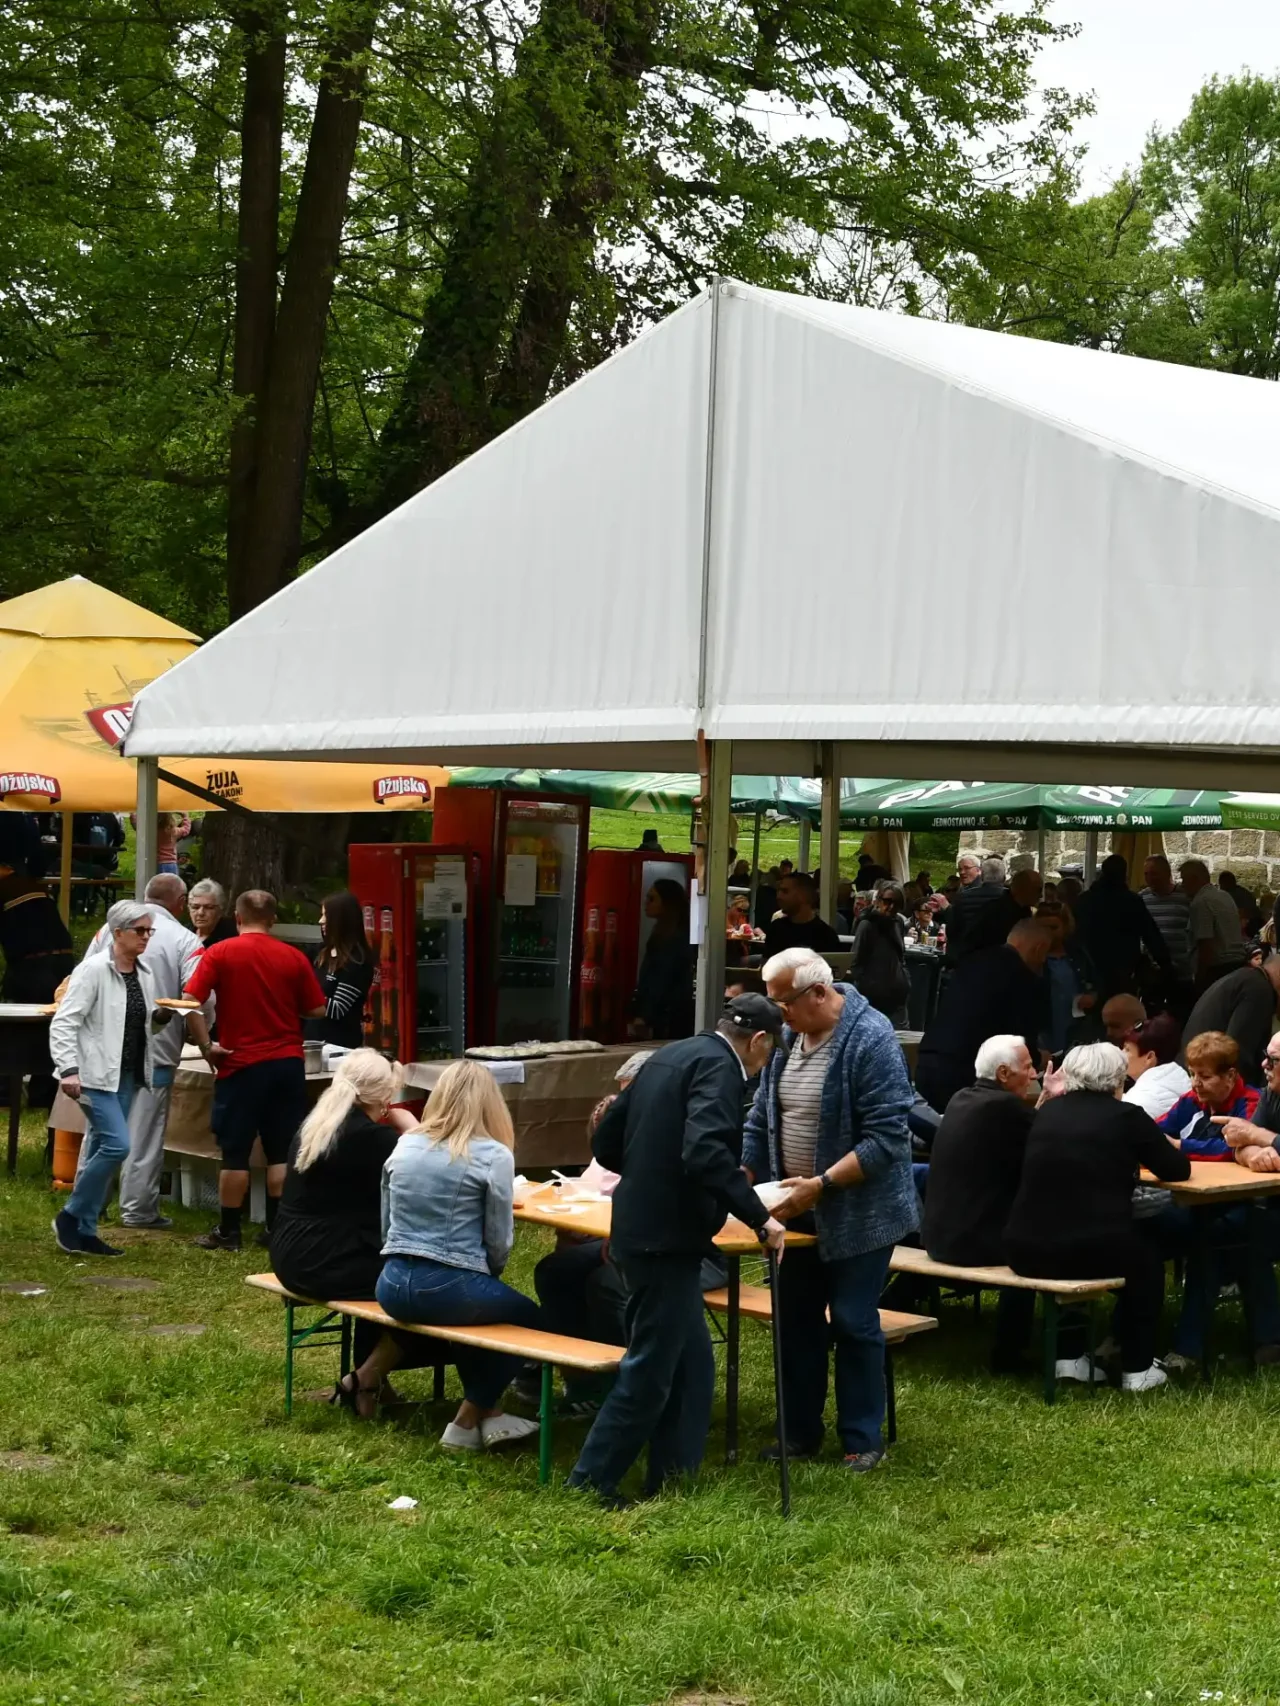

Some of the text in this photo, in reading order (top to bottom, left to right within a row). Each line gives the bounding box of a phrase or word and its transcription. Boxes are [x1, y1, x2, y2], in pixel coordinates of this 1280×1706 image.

[206, 770, 239, 791] ŽUJA
[378, 777, 427, 796] Ožujsko
[878, 780, 985, 809] PA
[883, 817, 903, 827] PAN
[932, 817, 976, 827] JEDNOSTAVNO
[1006, 816, 1028, 825] PAN
[1132, 815, 1153, 825] PAN
[1181, 814, 1222, 826] JEDNOSTAVNO
